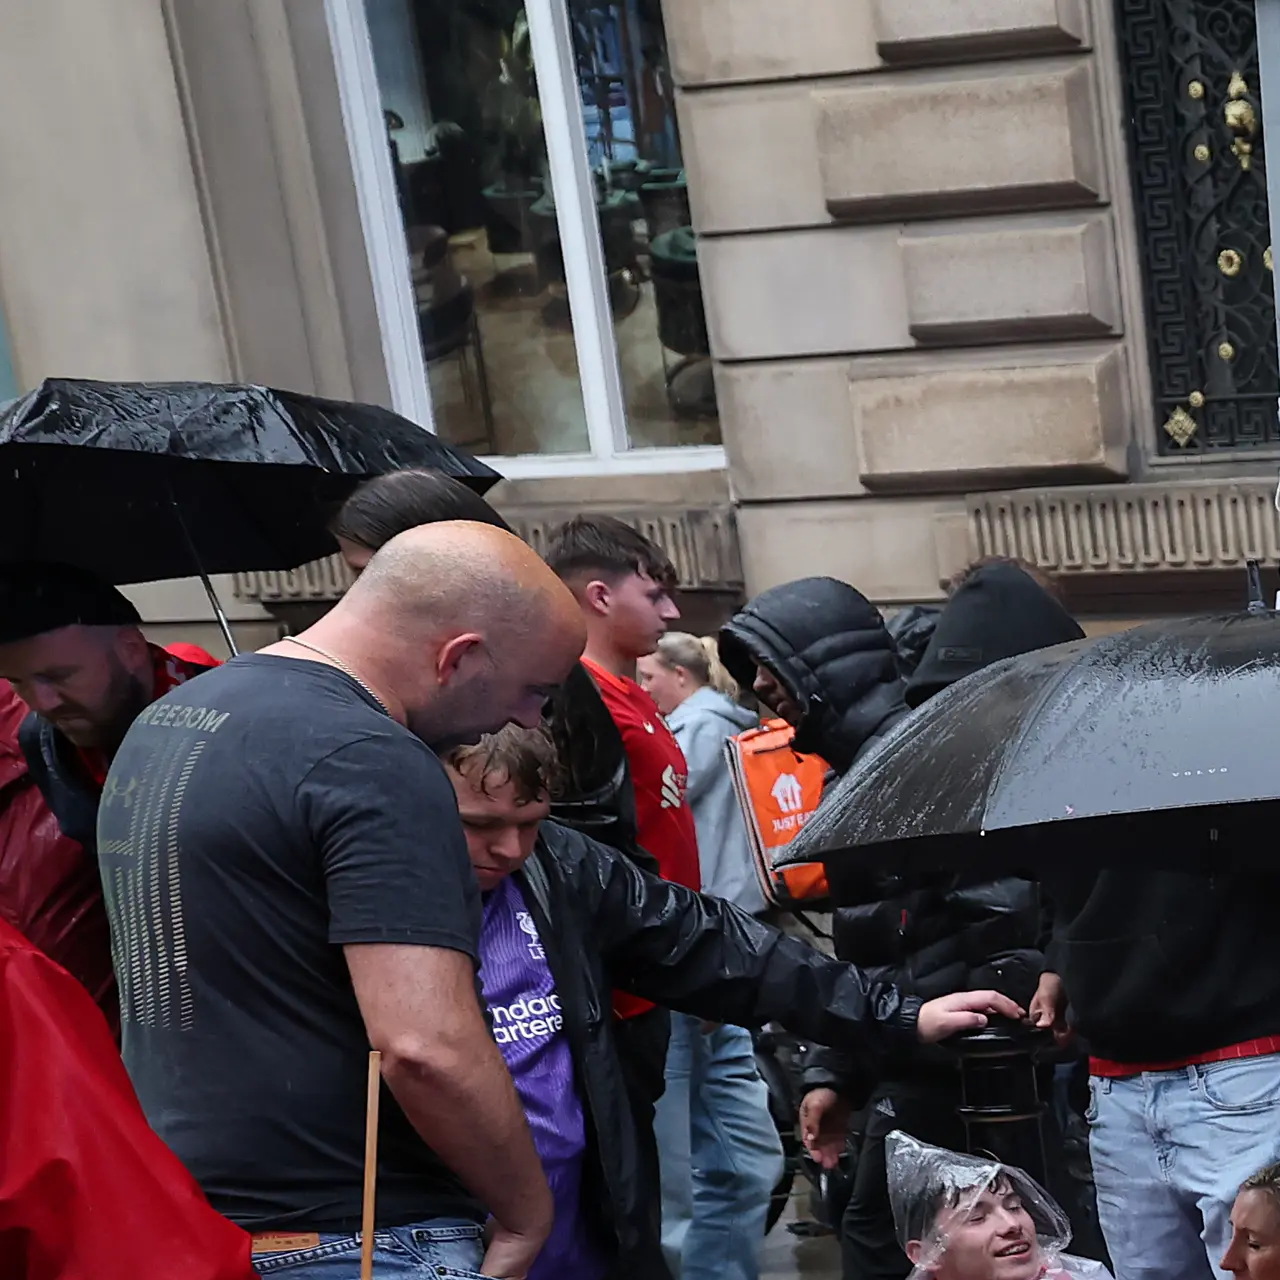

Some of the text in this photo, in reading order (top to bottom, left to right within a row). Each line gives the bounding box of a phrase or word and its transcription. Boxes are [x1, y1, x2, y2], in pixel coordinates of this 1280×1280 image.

[1172, 768, 1228, 777] VOLVO
[771, 810, 815, 833] JUST EA
